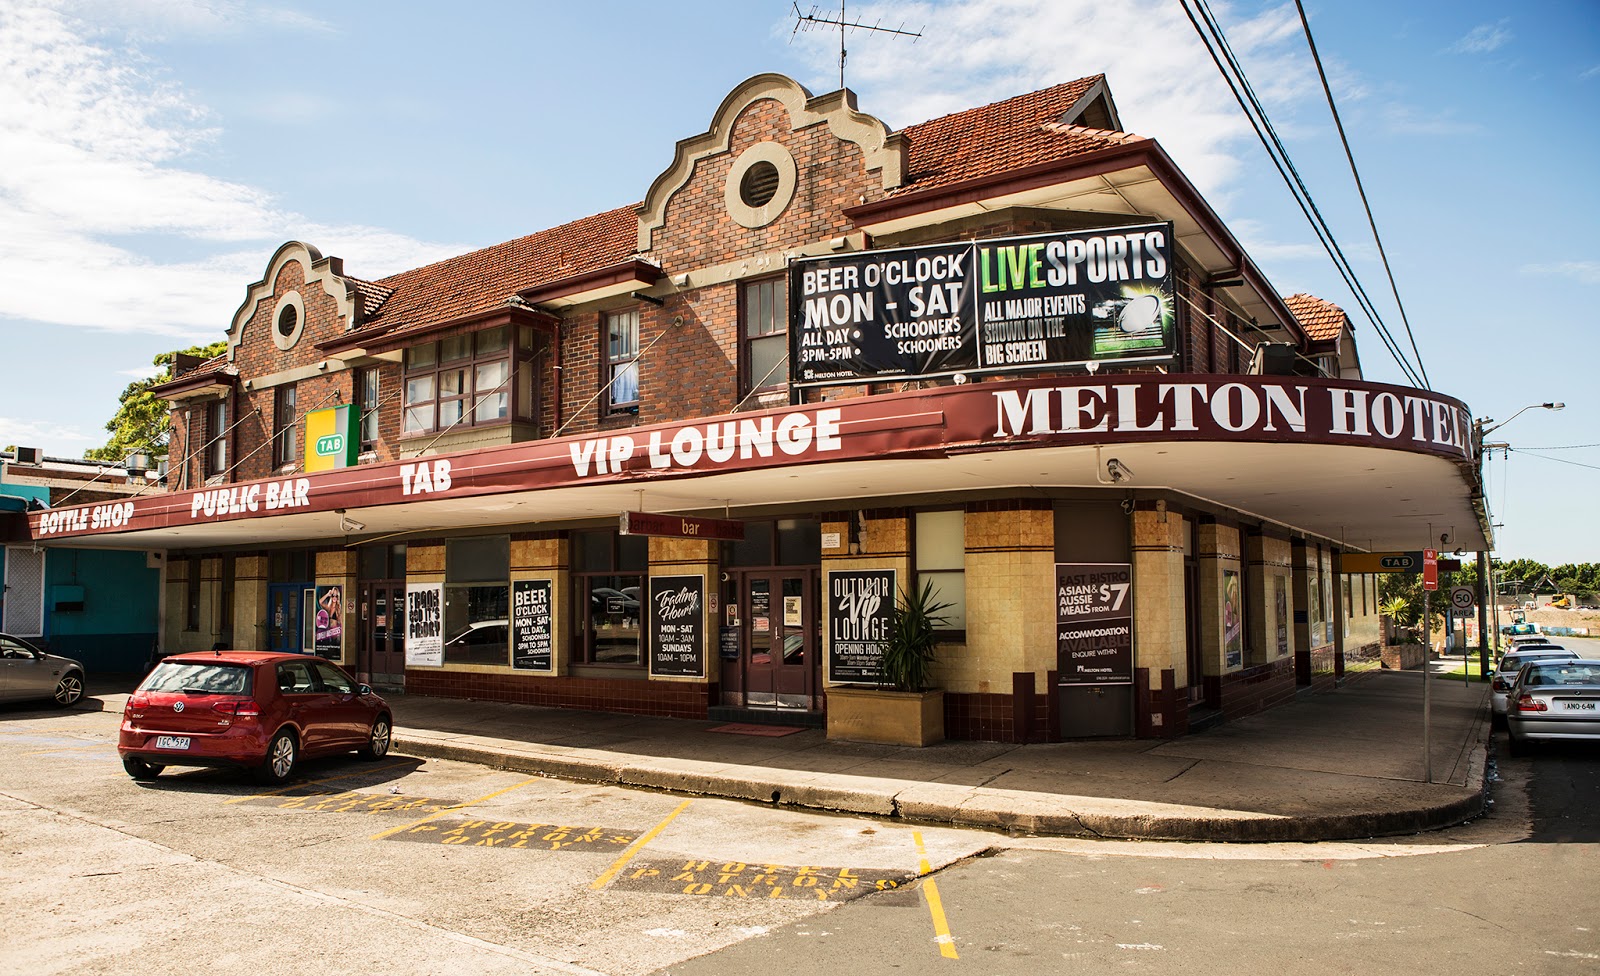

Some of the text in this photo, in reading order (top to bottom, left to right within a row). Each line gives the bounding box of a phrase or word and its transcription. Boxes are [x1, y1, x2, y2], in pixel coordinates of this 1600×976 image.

[803, 254, 964, 296] BEER O'CLOCK
[804, 291, 874, 329] MON
[909, 282, 963, 318] SAT
[984, 294, 1086, 322] ALL MAJOR EVENTS
[884, 316, 962, 339] SCHOONERS
[984, 317, 1066, 343] SHOWN ON THE
[802, 328, 850, 347] ALL DAY
[898, 336, 962, 355] SCHOONERS
[802, 346, 852, 362] 3PM-5PM
[986, 340, 1047, 365] BIG SCREEN
[836, 370, 854, 378] HOTEL
[991, 381, 1307, 438] MELTON
[1326, 387, 1464, 449] HOTEL
[320, 440, 341, 453] TAB
[569, 408, 842, 477] VIP LOUNGE
[400, 459, 452, 495] TAB
[191, 477, 310, 518] PUBLIC BAR
[39, 501, 135, 535] BOTTLE SHOP
[682, 518, 700, 535] bar
[1059, 571, 1129, 587] EAST BISTRO
[834, 577, 889, 598] OUTDOOR
[515, 589, 547, 606] BEER
[655, 586, 698, 608] Trading
[1059, 585, 1091, 597] ASIAN
[1099, 583, 1130, 611] $7
[1059, 595, 1093, 606] AUSSIE
[1456, 594, 1470, 603] 50
[515, 604, 547, 616] O'CLOCK
[658, 605, 695, 621] Hours
[1060, 604, 1110, 616] MEALS FROM
[515, 617, 532, 628] MON
[537, 616, 549, 625] SAT
[660, 625, 676, 633] MON
[680, 625, 693, 633] SAT
[834, 617, 889, 641] LOUNGE
[520, 626, 544, 635] ALL DAY
[522, 633, 550, 642] SCHOONERS
[659, 634, 675, 642] 10AM
[680, 634, 694, 643] 3AM
[1059, 627, 1128, 641] ACCOMMODATION
[527, 647, 550, 655] SCHOONERS
[529, 641, 536, 649] TO
[662, 644, 692, 652] SUNDAYS
[834, 643, 864, 655] OPENING
[1060, 636, 1129, 652] AVAILABLE
[657, 653, 673, 661] 10AM
[1072, 648, 1117, 658] ENQUIRE WITHIN
[408, 825, 636, 844] PATRONS
[460, 820, 603, 835] HOTEL
[441, 836, 573, 850] ONLY
[682, 860, 858, 878] HOTEL
[630, 868, 898, 890] PATRONS
[682, 883, 840, 901] ONLY
